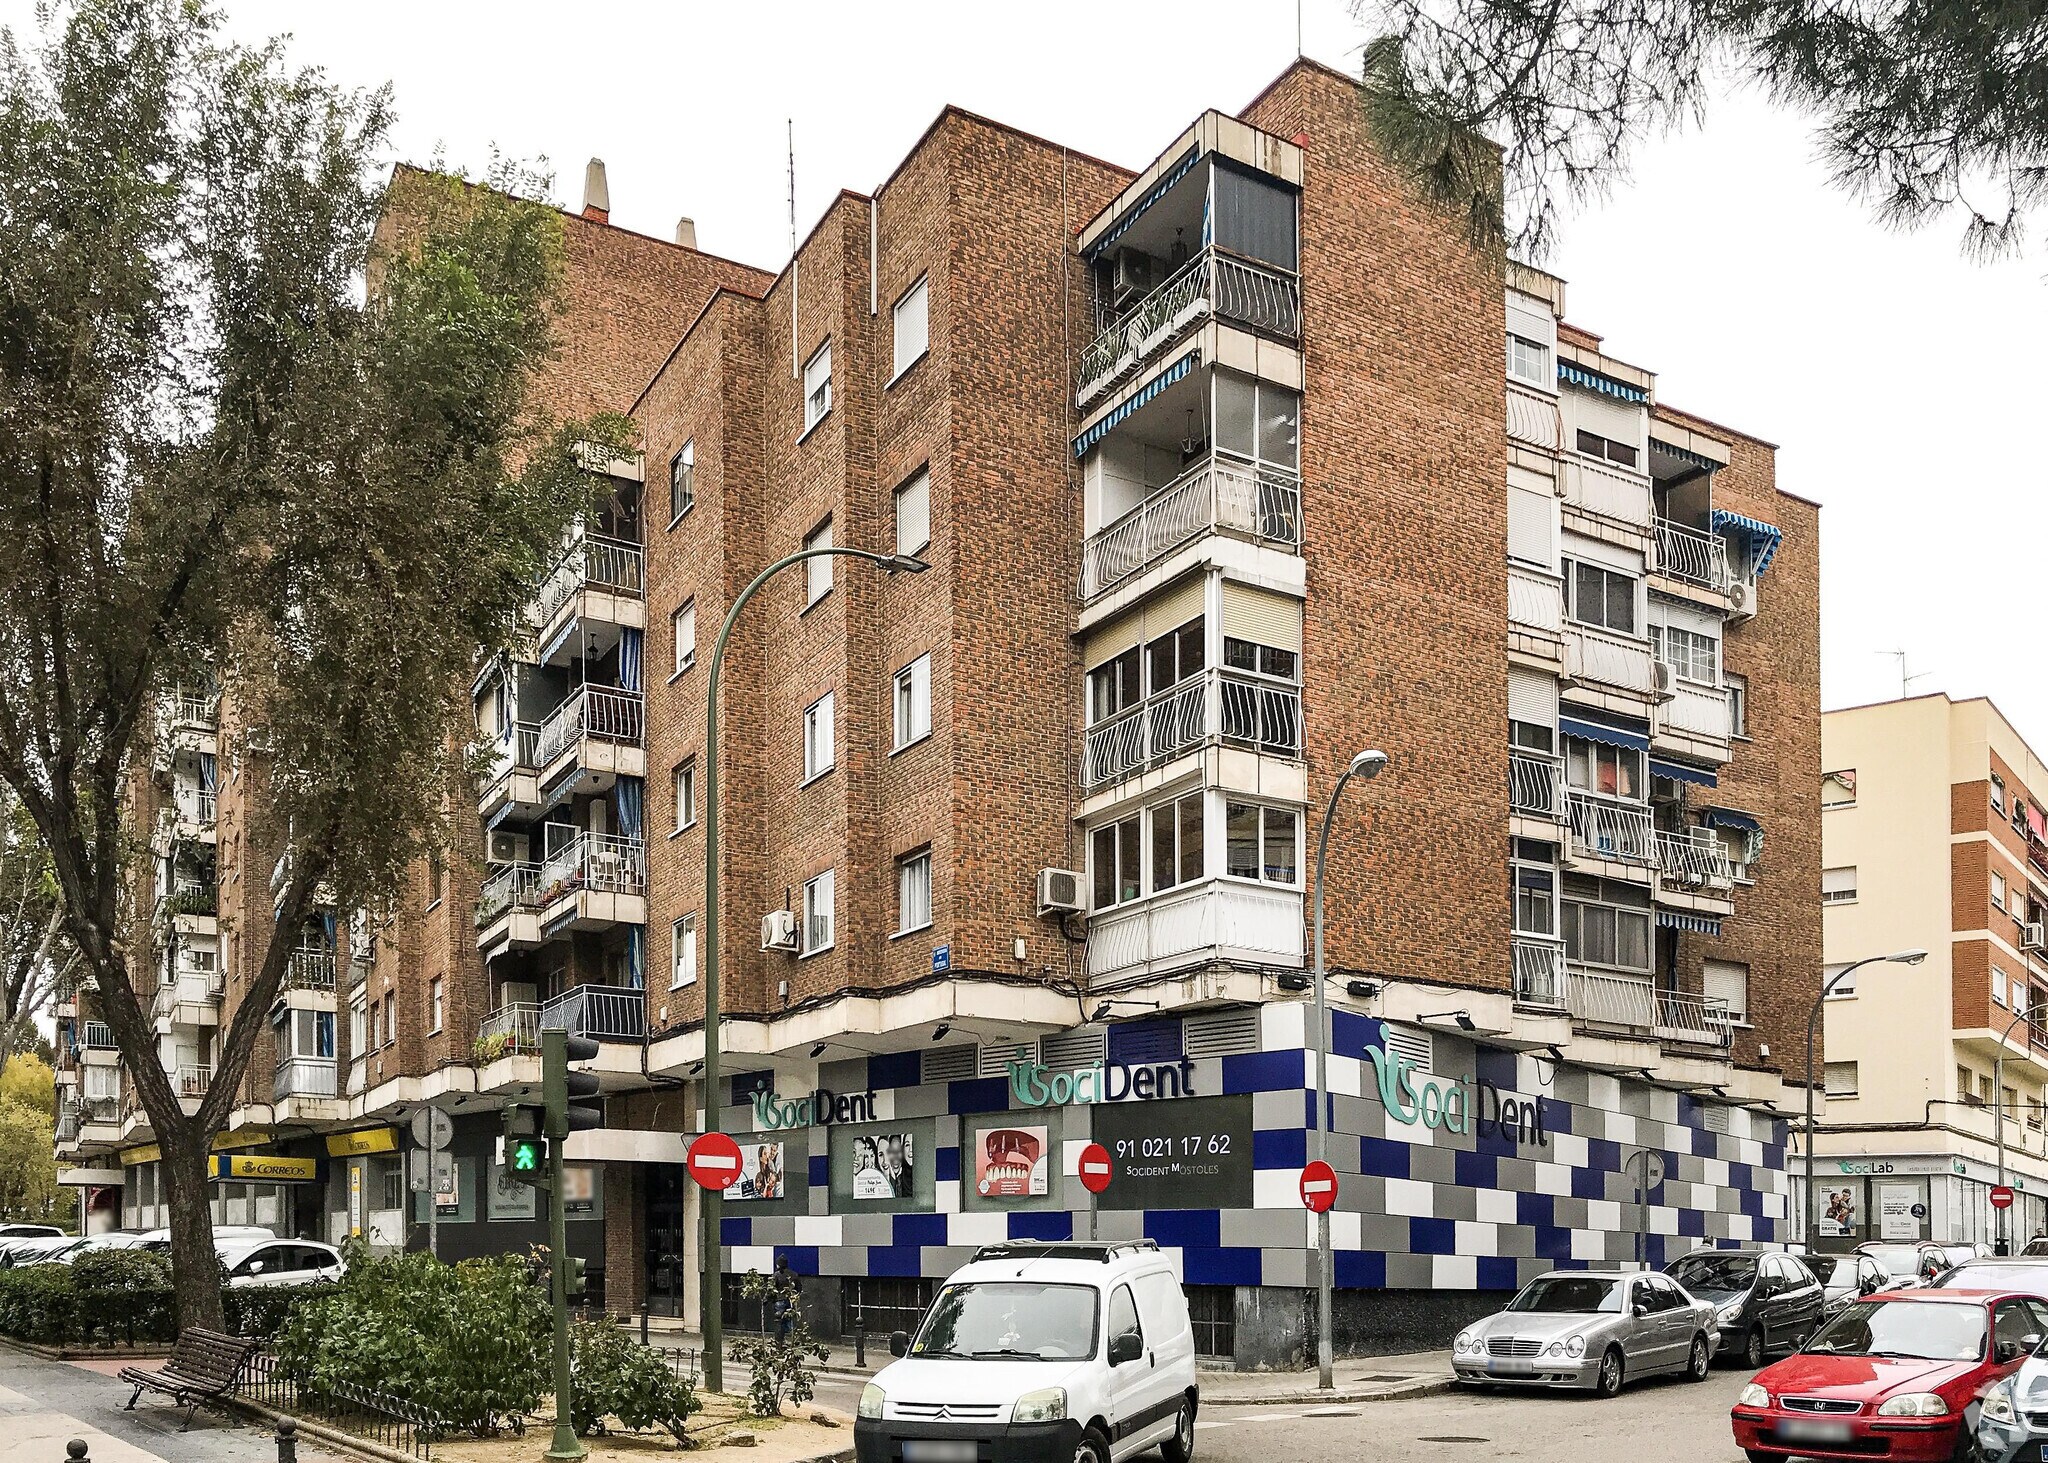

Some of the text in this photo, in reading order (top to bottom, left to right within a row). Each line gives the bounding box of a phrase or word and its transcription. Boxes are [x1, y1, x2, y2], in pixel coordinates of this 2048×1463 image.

[1010, 1056, 1195, 1106] SociDent
[756, 1088, 877, 1129] SociDent
[1116, 1134, 1231, 1158] 91 021 17 62
[1845, 1161, 1894, 1174] SociLab
